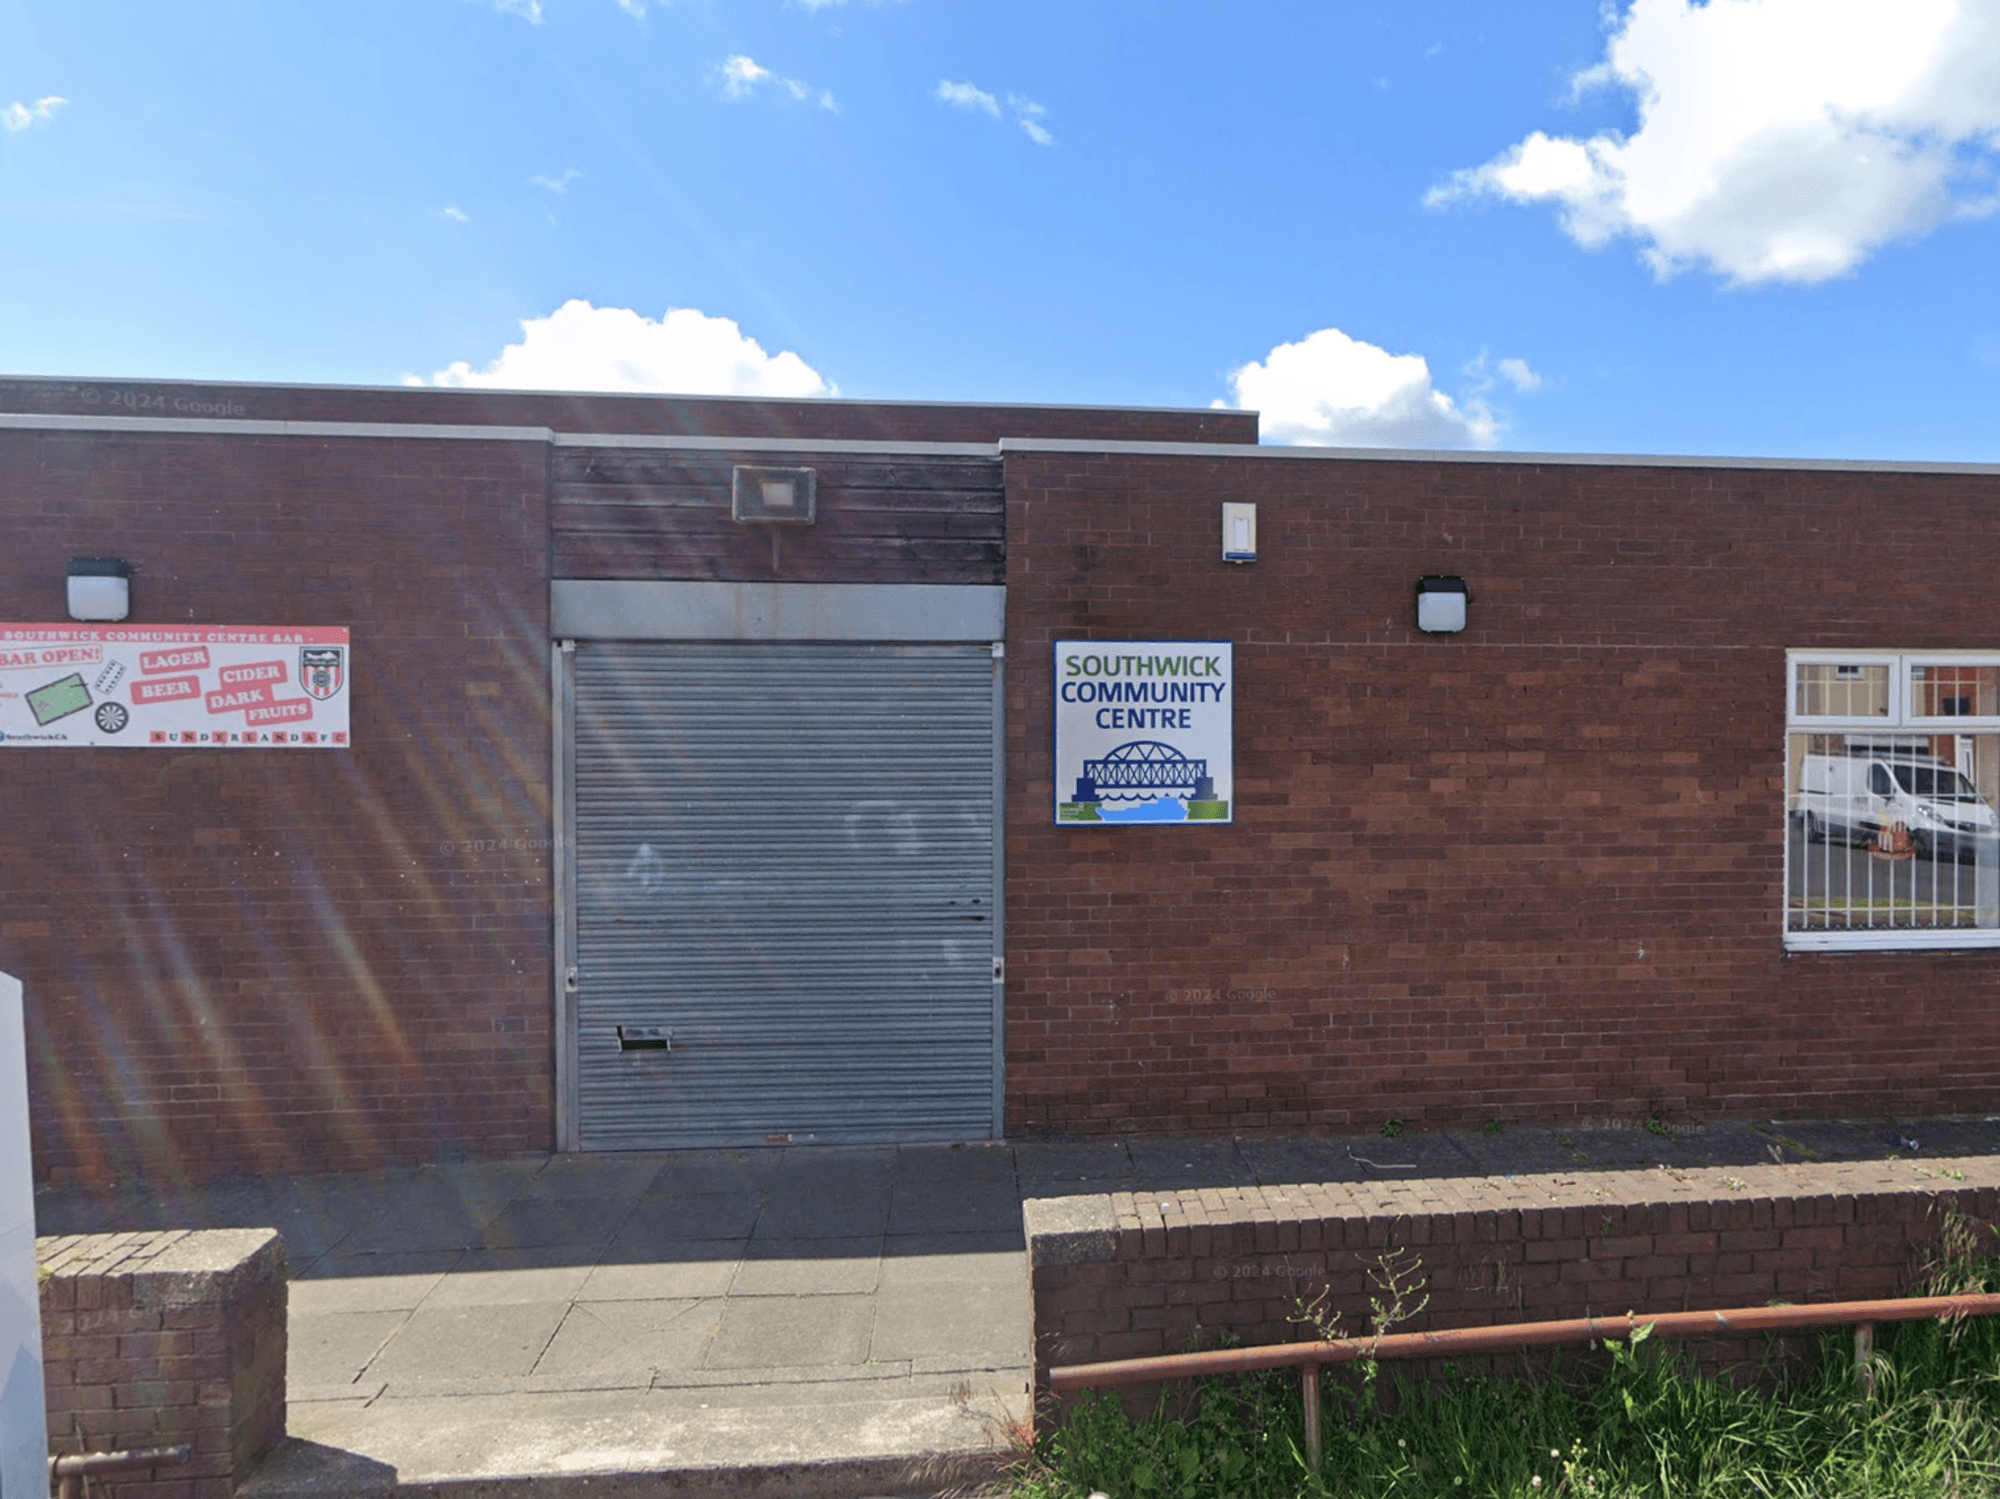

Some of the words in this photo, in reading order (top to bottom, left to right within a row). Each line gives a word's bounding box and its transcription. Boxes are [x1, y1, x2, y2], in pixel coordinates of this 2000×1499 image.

[4, 630, 100, 642] SOUTHWICK
[105, 631, 201, 643] COMMUNITY
[206, 632, 269, 643] CENTRE
[273, 633, 304, 643] BAR
[0, 652, 37, 667] BAR
[41, 647, 101, 663] OPEN!
[142, 650, 208, 669] LAGER
[1065, 655, 1222, 677] SOUTHWICK
[223, 666, 281, 684] CIDER
[141, 681, 192, 698] BEER
[210, 689, 265, 709] DARK
[1061, 681, 1226, 703] COMMUNITY
[249, 703, 308, 721] FRUITS
[1095, 708, 1192, 729] CENTRE
